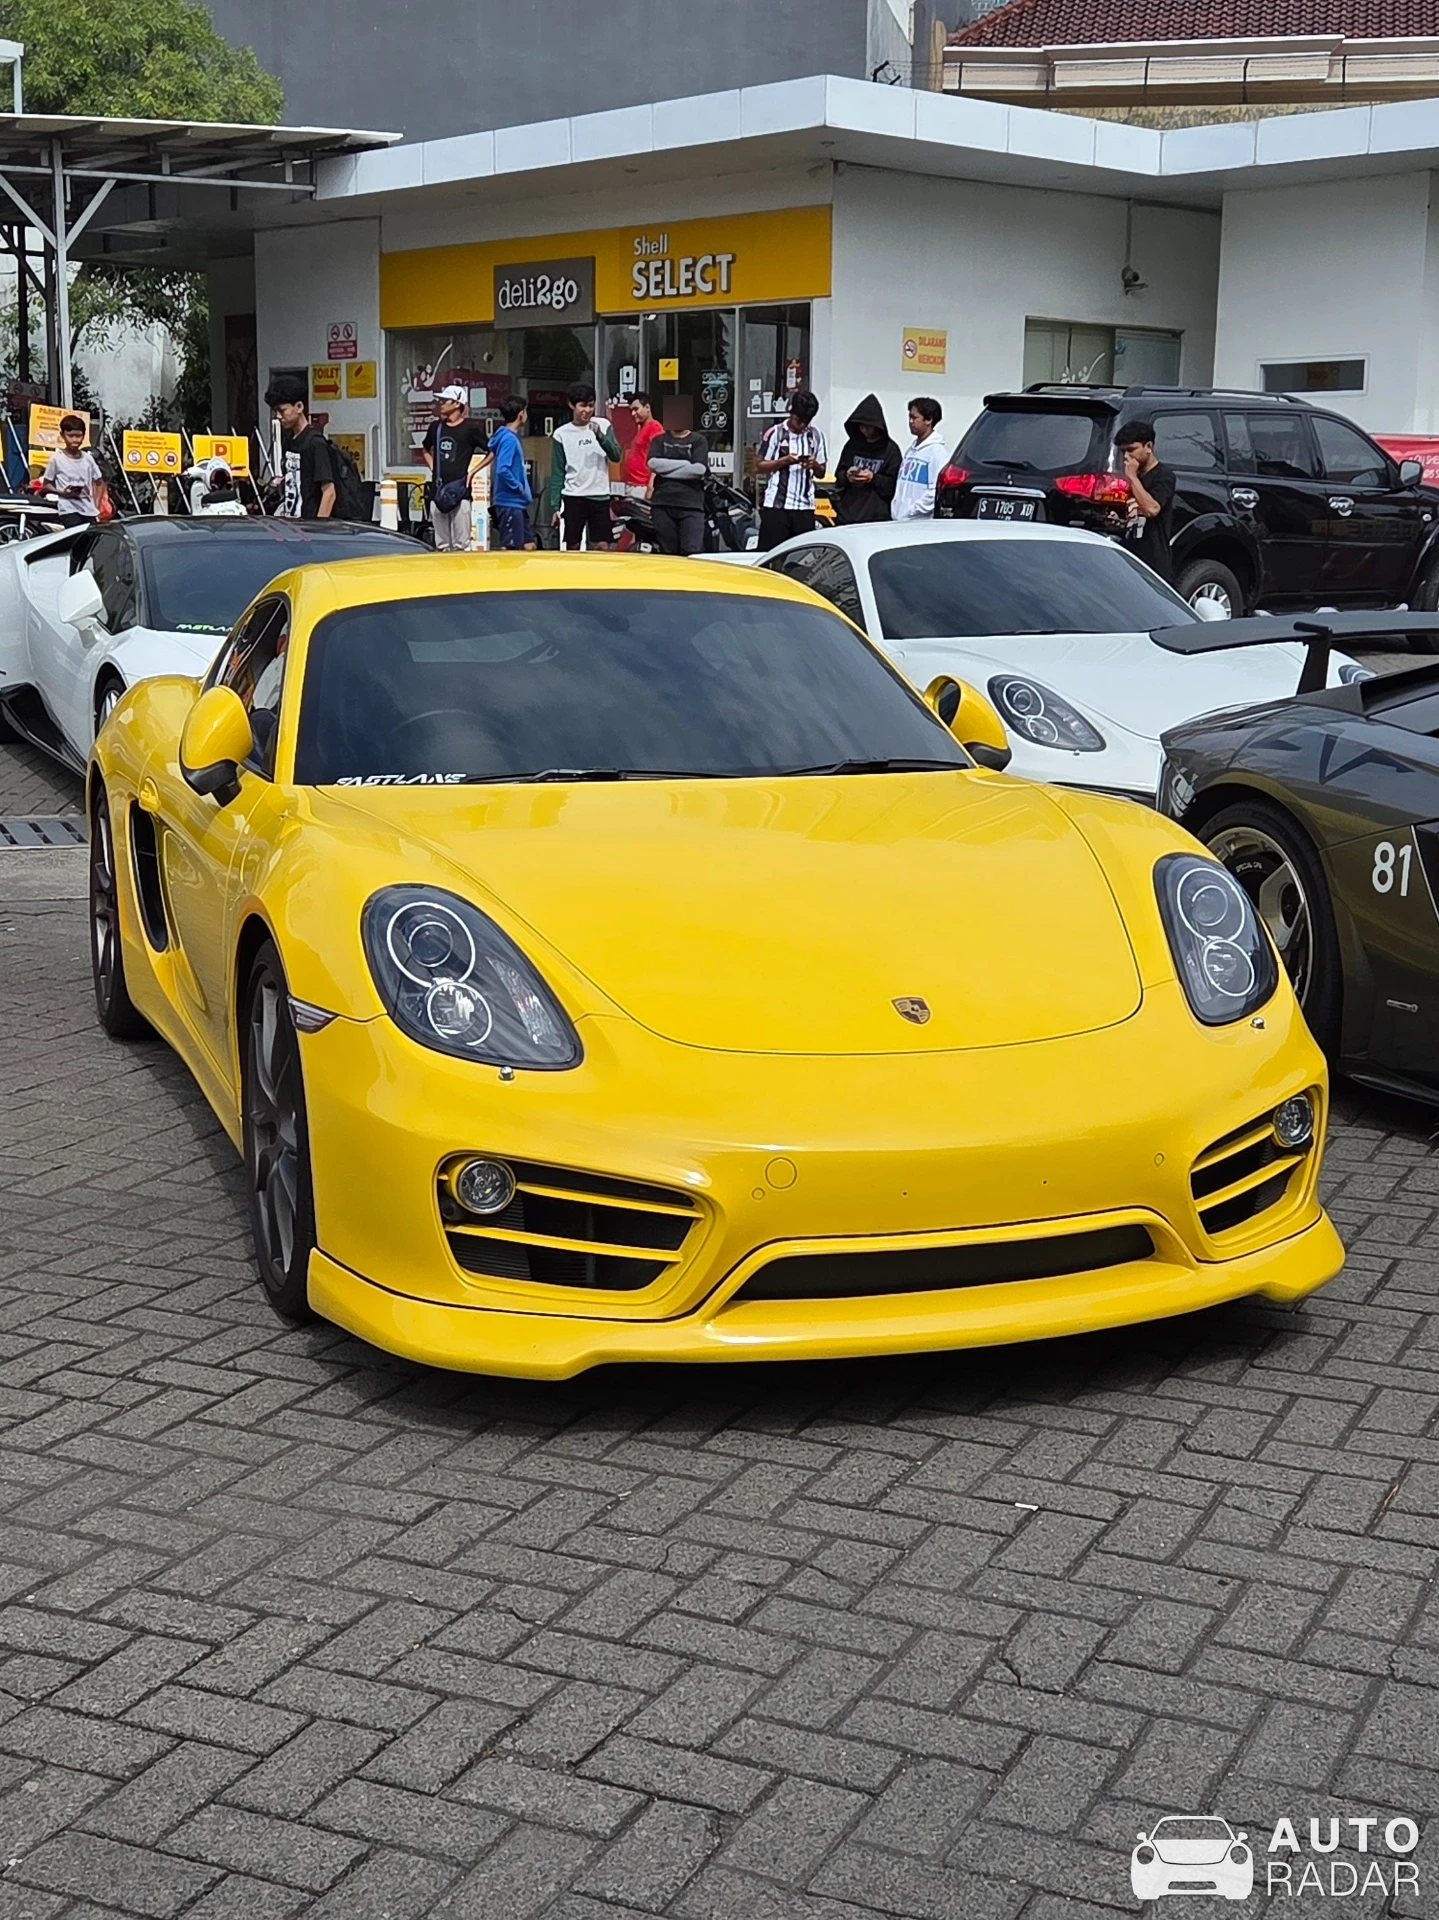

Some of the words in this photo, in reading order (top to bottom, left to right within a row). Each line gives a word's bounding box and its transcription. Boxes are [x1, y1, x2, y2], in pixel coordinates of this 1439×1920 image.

[633, 233, 668, 256] Shell
[631, 253, 733, 298] SELECT
[498, 274, 578, 309] deli2go
[918, 336, 946, 348] DILARANG
[313, 367, 339, 379] TOILET
[708, 456, 726, 468] ULL
[980, 500, 988, 513] S
[994, 501, 1015, 515] 1705
[1019, 503, 1033, 517] XD
[335, 773, 466, 788] FASTLANE
[1372, 841, 1413, 897] 81
